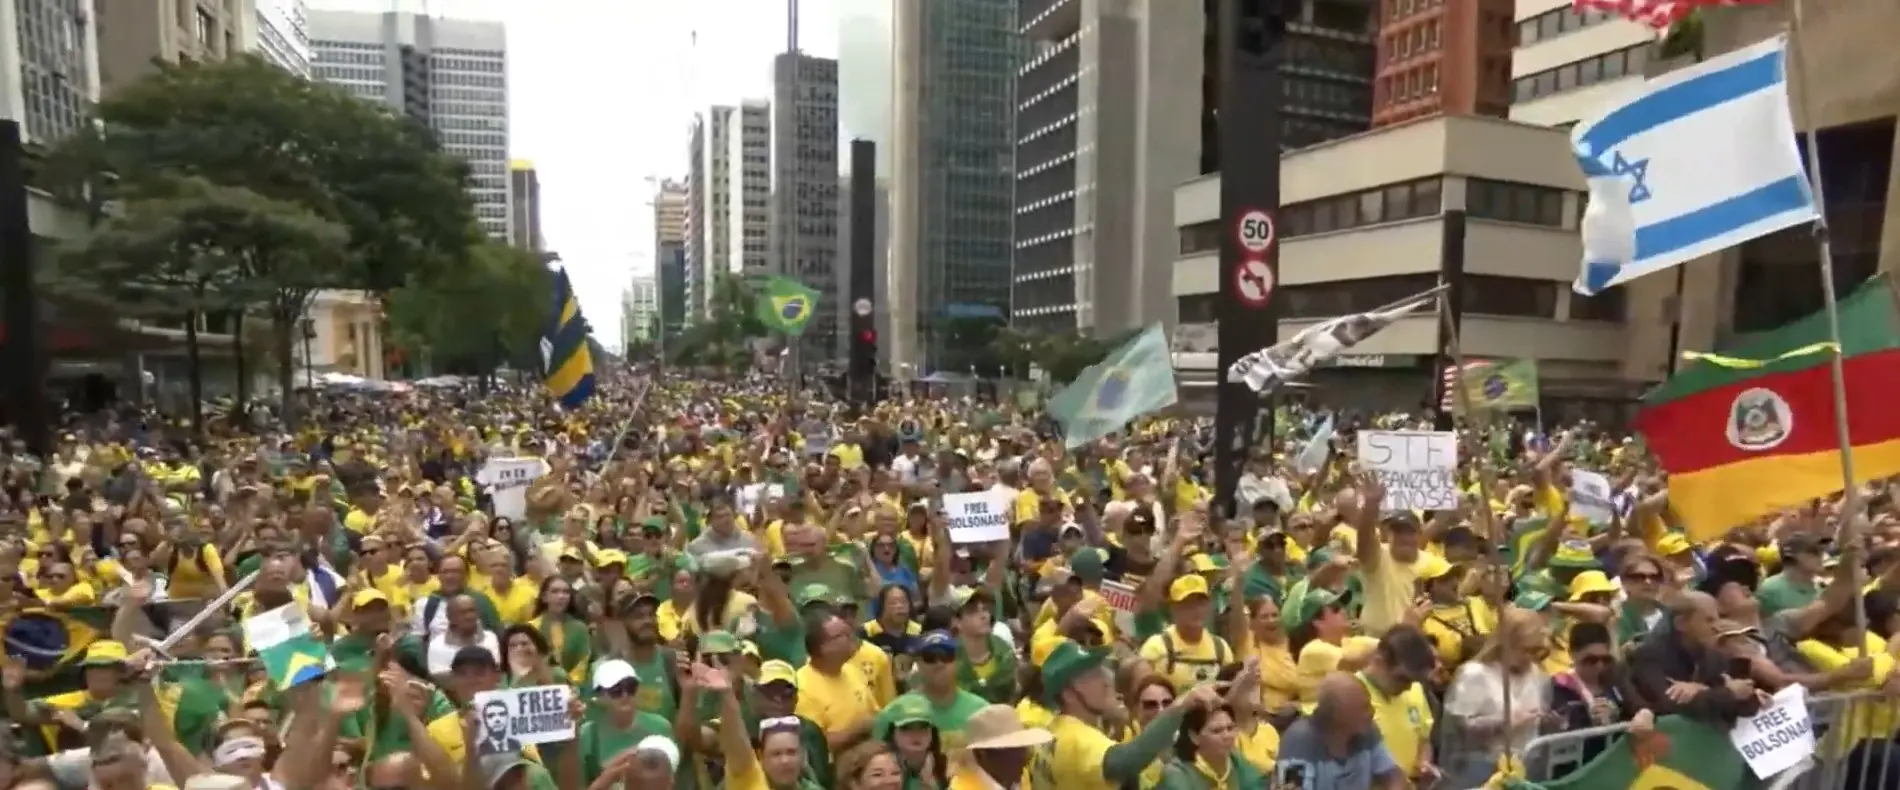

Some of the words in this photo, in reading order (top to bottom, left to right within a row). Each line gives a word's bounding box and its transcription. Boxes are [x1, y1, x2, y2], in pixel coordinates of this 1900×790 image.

[1244, 219, 1269, 240] 50
[1367, 432, 1447, 467] STF
[963, 502, 988, 515] FREE
[949, 513, 1007, 530] BOLSONARO
[517, 689, 563, 715] FREE
[1752, 707, 1792, 733] FREE
